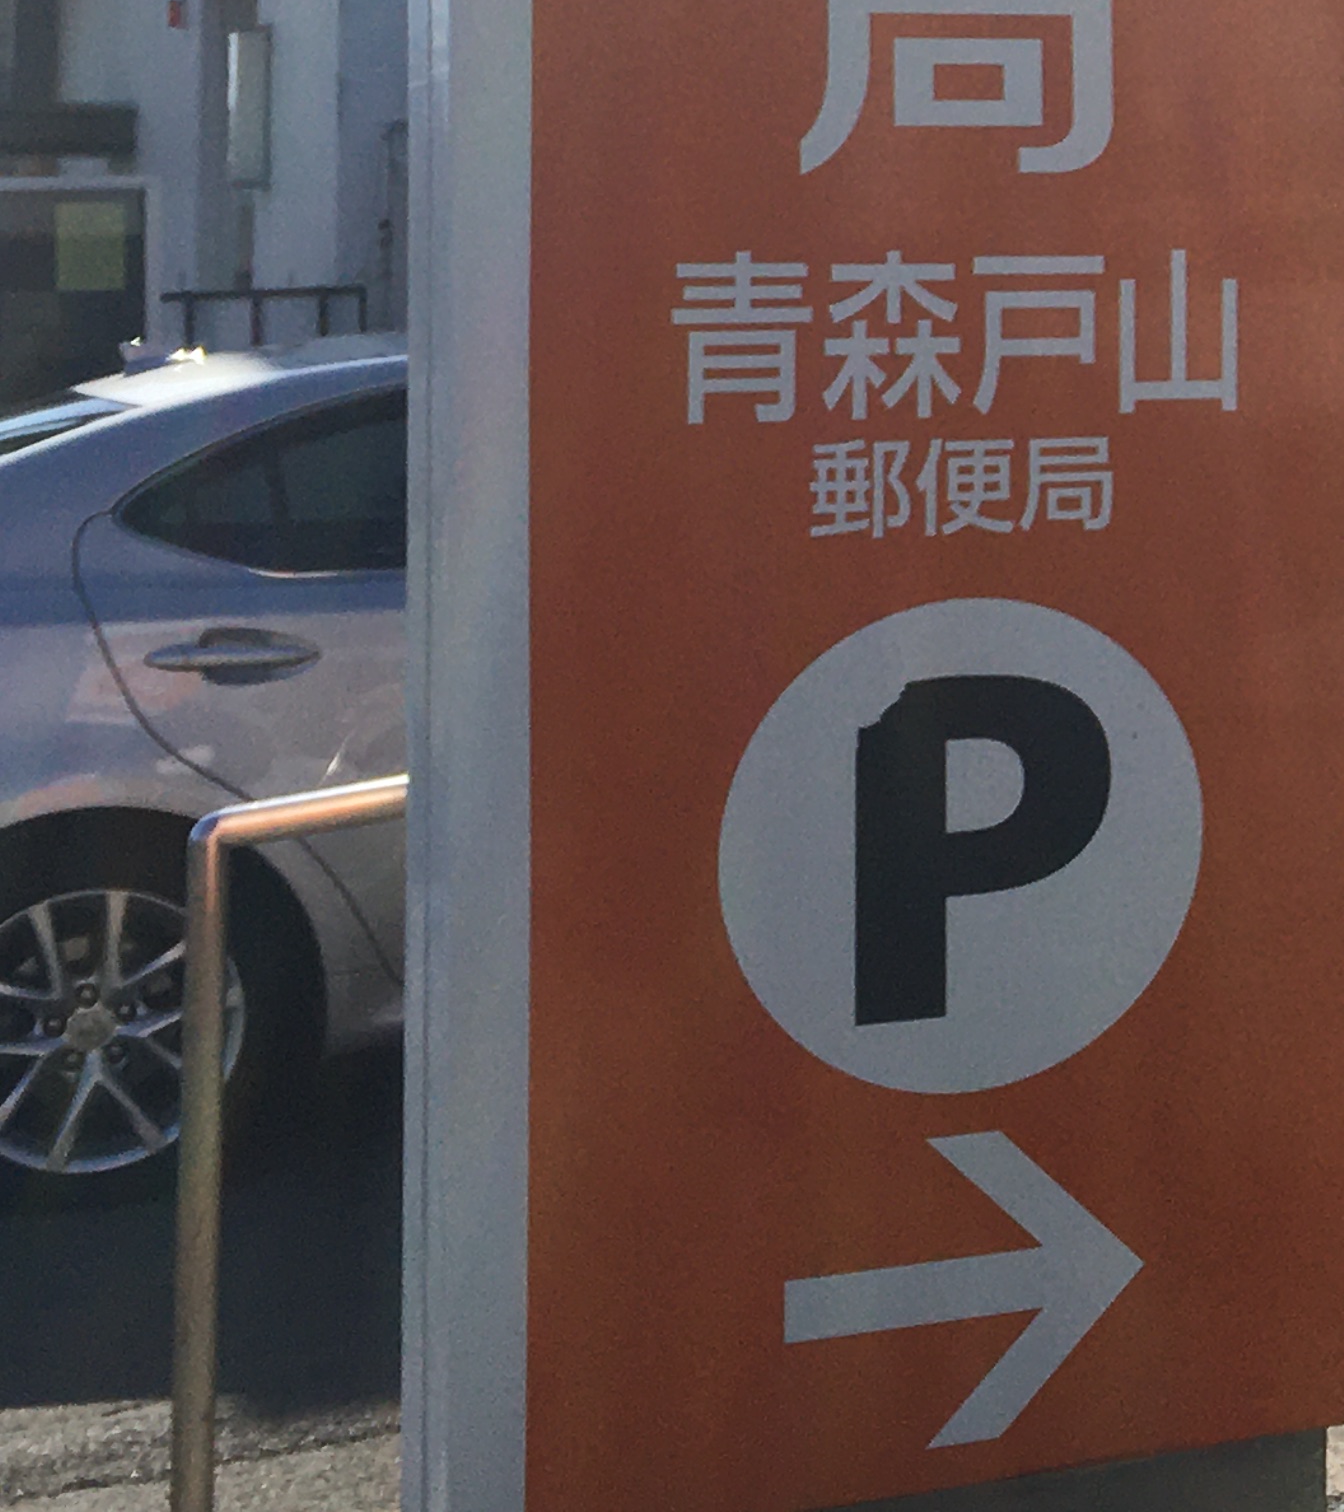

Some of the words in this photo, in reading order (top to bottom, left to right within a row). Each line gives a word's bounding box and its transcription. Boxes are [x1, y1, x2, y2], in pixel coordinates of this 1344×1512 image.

[670, 248, 1239, 425] 青森戸山
[808, 434, 1115, 539] 郵便局
[854, 673, 1113, 1027] P
